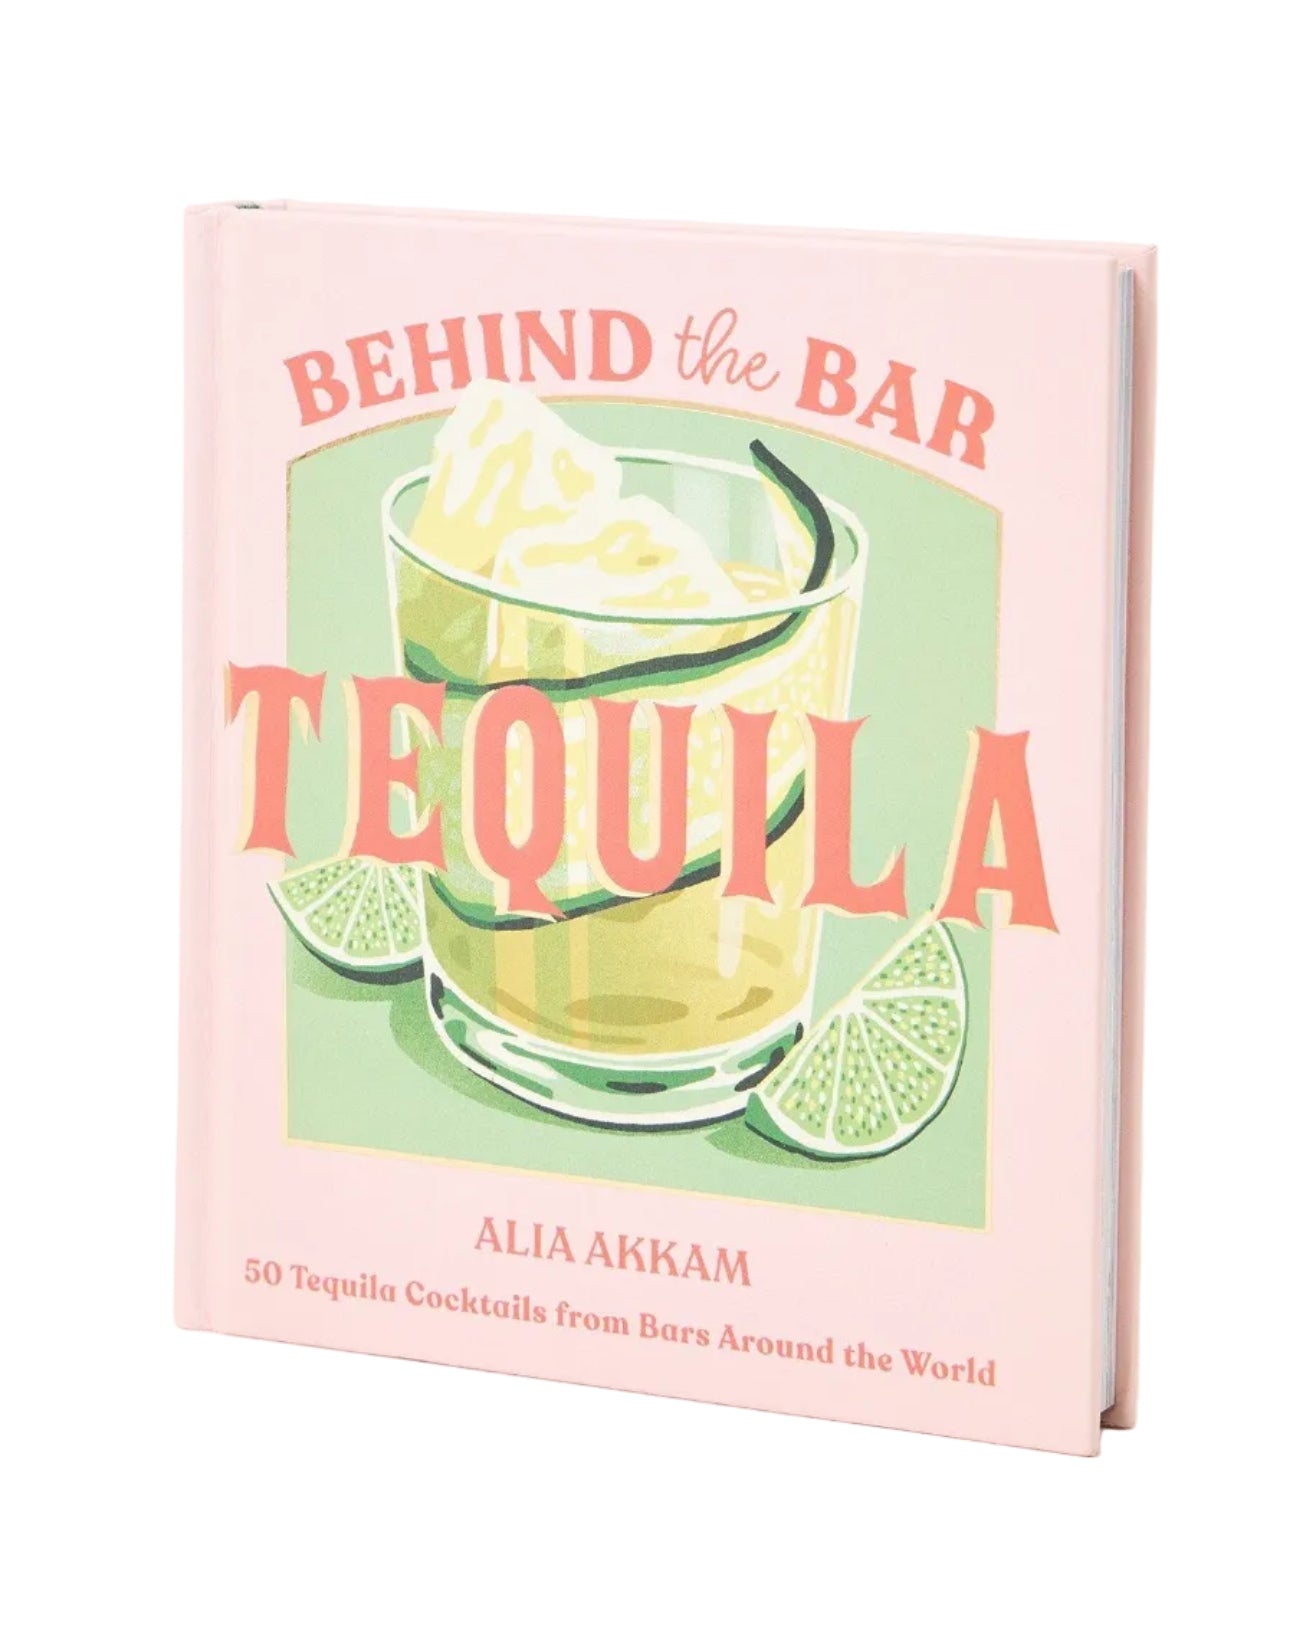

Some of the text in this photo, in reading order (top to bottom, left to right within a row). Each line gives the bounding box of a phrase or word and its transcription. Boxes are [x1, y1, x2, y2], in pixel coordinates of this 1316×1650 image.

[283, 306, 996, 470] BEHIND the BAR
[227, 662, 1060, 934] TEQUILA
[245, 1257, 996, 1388] 50 Tequila Cocktails from Bars Around the World
[474, 1216, 752, 1286] ALIA AKKAM
